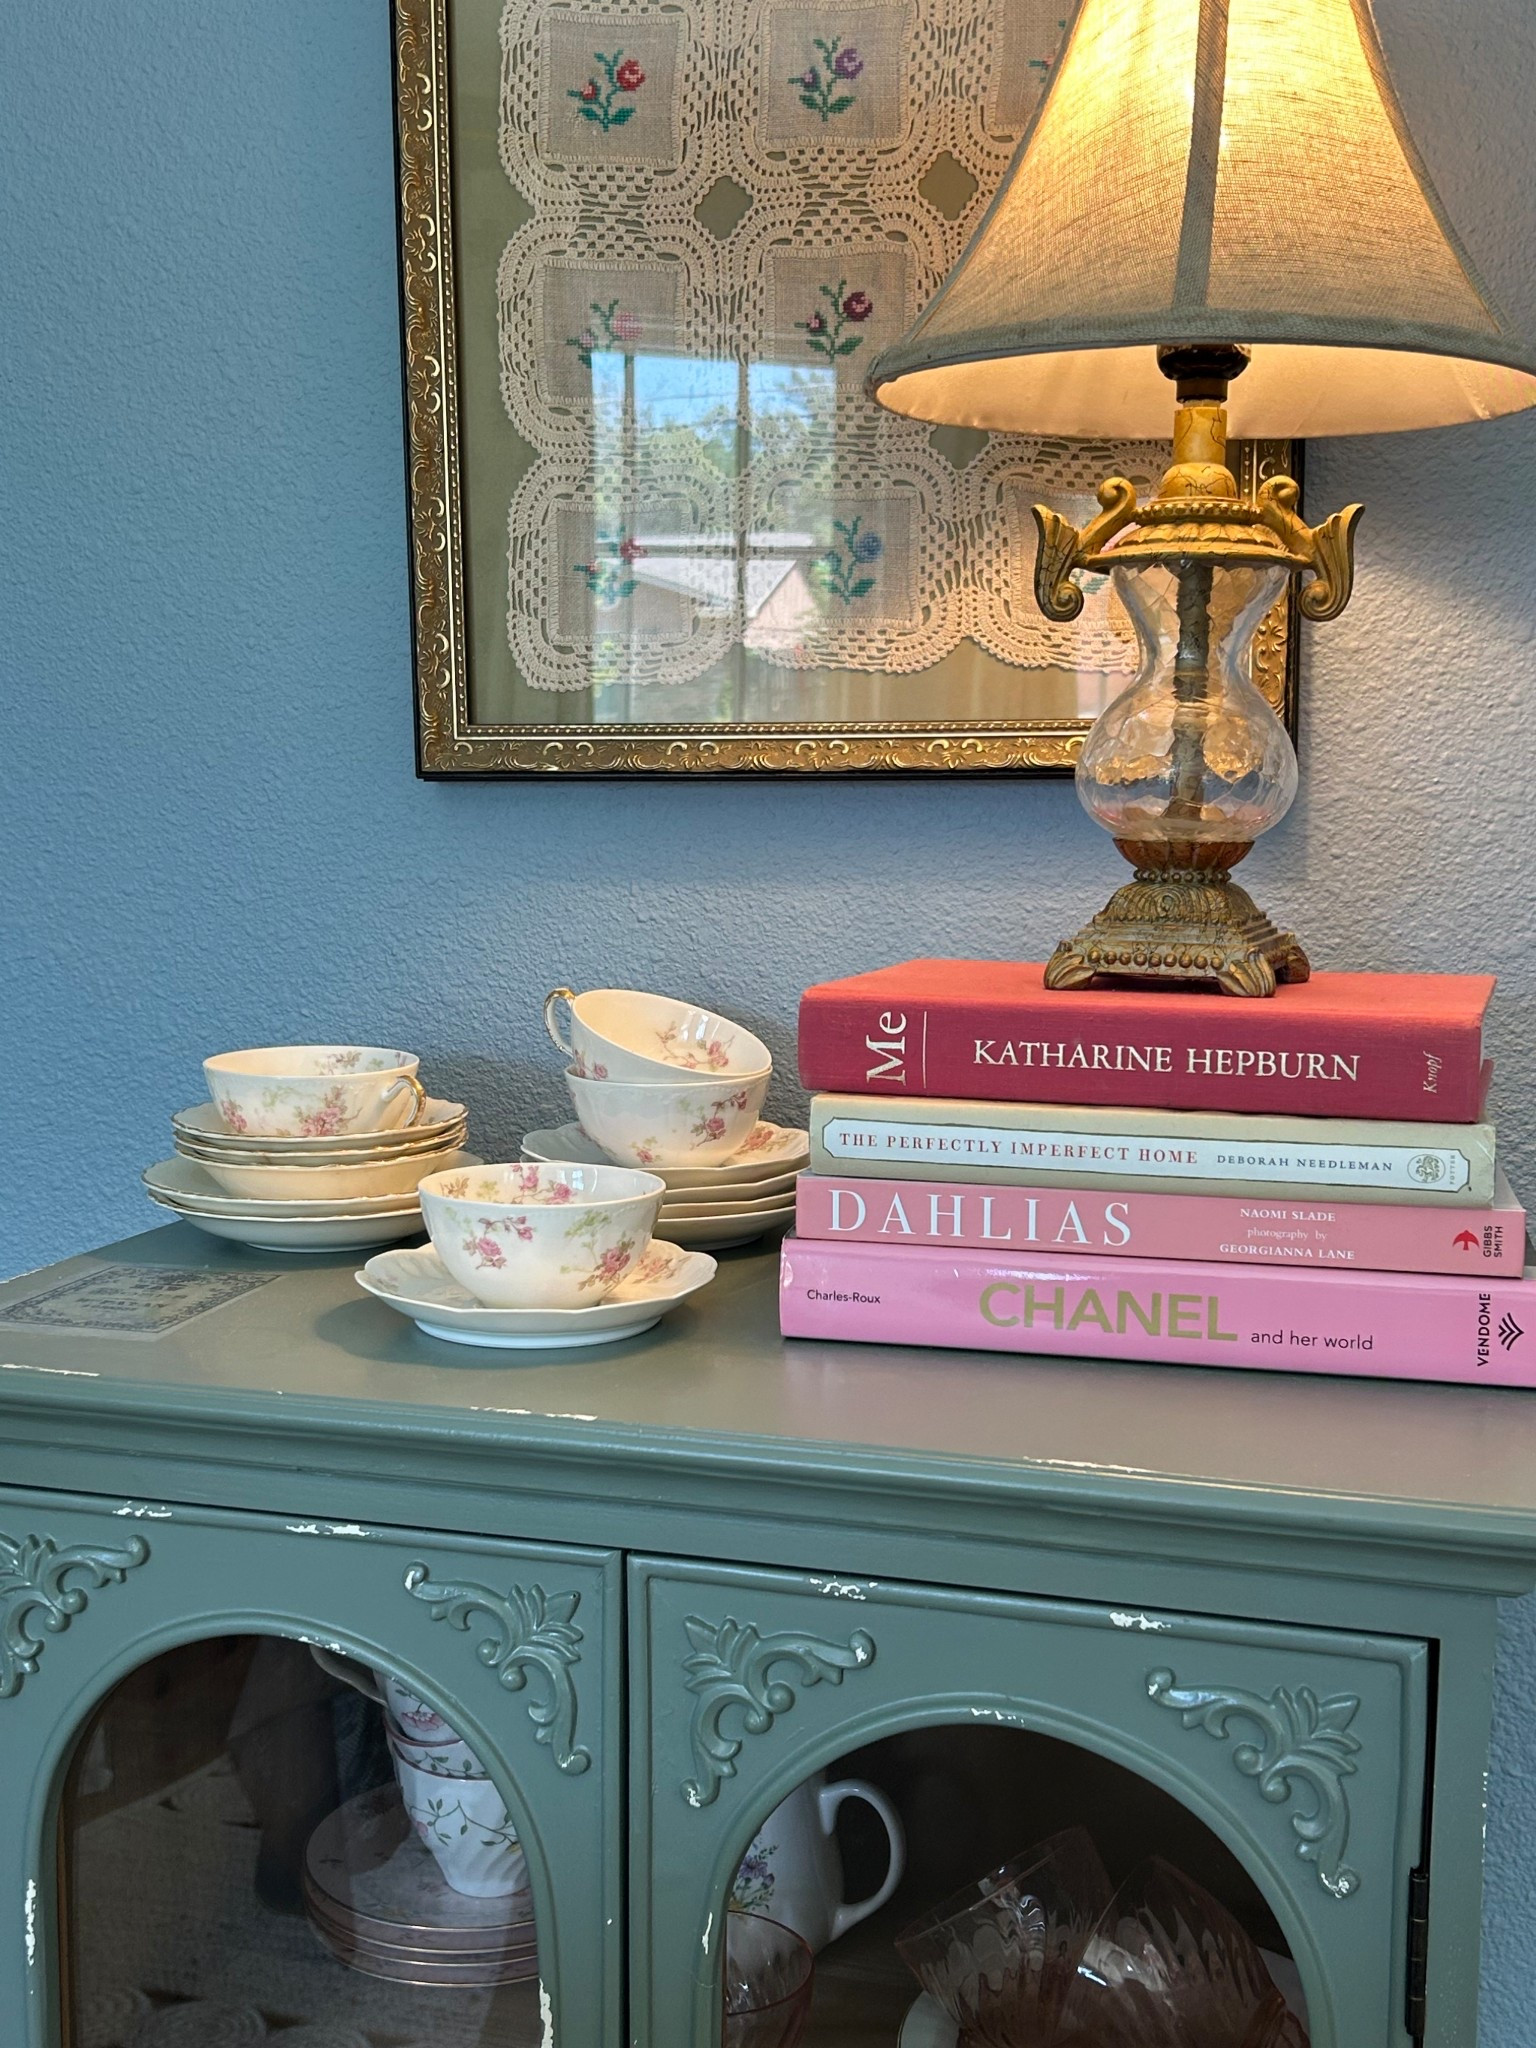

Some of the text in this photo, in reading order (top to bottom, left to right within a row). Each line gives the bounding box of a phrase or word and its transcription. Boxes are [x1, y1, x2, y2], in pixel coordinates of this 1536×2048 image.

[865, 1011, 907, 1086] Me
[973, 1039, 1360, 1082] KATHARINE HEPBURN
[1423, 1051, 1443, 1094] Knopf
[839, 1133, 1198, 1164] THE PERFECTLY IMPERFECT HOME
[1217, 1155, 1393, 1172] DEBORAH NEEDLEMAN
[828, 1189, 1131, 1246] DAHLIAS
[1240, 1208, 1336, 1222] NAOMI SLADE
[1247, 1227, 1328, 1242] photography by
[1483, 1225, 1493, 1258] GIBBS
[1494, 1226, 1503, 1258] SMITH
[1219, 1243, 1355, 1260] GEORGIANNA LANE
[807, 1289, 881, 1304] Charles-Roux
[979, 1282, 1238, 1342] CHANEL
[1250, 1330, 1374, 1351] and her world
[1477, 1293, 1491, 1367] VENDOME
